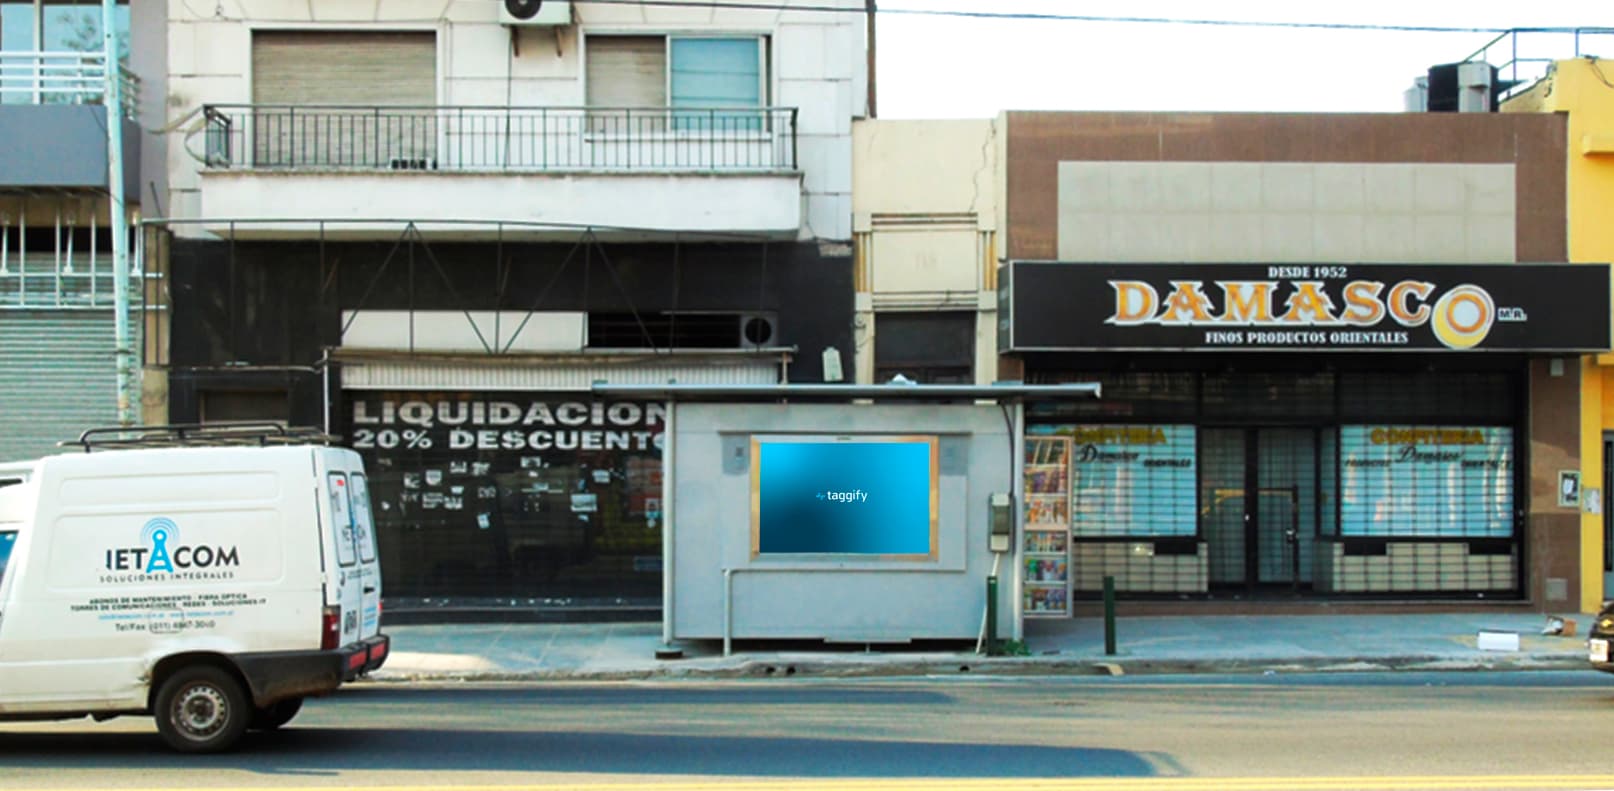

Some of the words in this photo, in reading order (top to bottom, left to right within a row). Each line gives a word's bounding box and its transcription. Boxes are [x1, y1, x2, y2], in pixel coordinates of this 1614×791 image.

[1268, 266, 1310, 278] DESDE
[1313, 266, 1347, 278] 1952
[1104, 279, 1496, 349] DAMASCO
[1205, 331, 1244, 344] FINOS
[1247, 331, 1327, 344] PRODUCTOS
[1330, 331, 1408, 344] ORIENTALES
[353, 401, 666, 428] LIQUIDACION
[352, 429, 433, 449] 20%
[1371, 427, 1485, 445] CONFITERIA
[827, 489, 869, 503] taggify
[100, 573, 166, 583] SOLUCIONES
[170, 571, 234, 580] INTEGRALES
